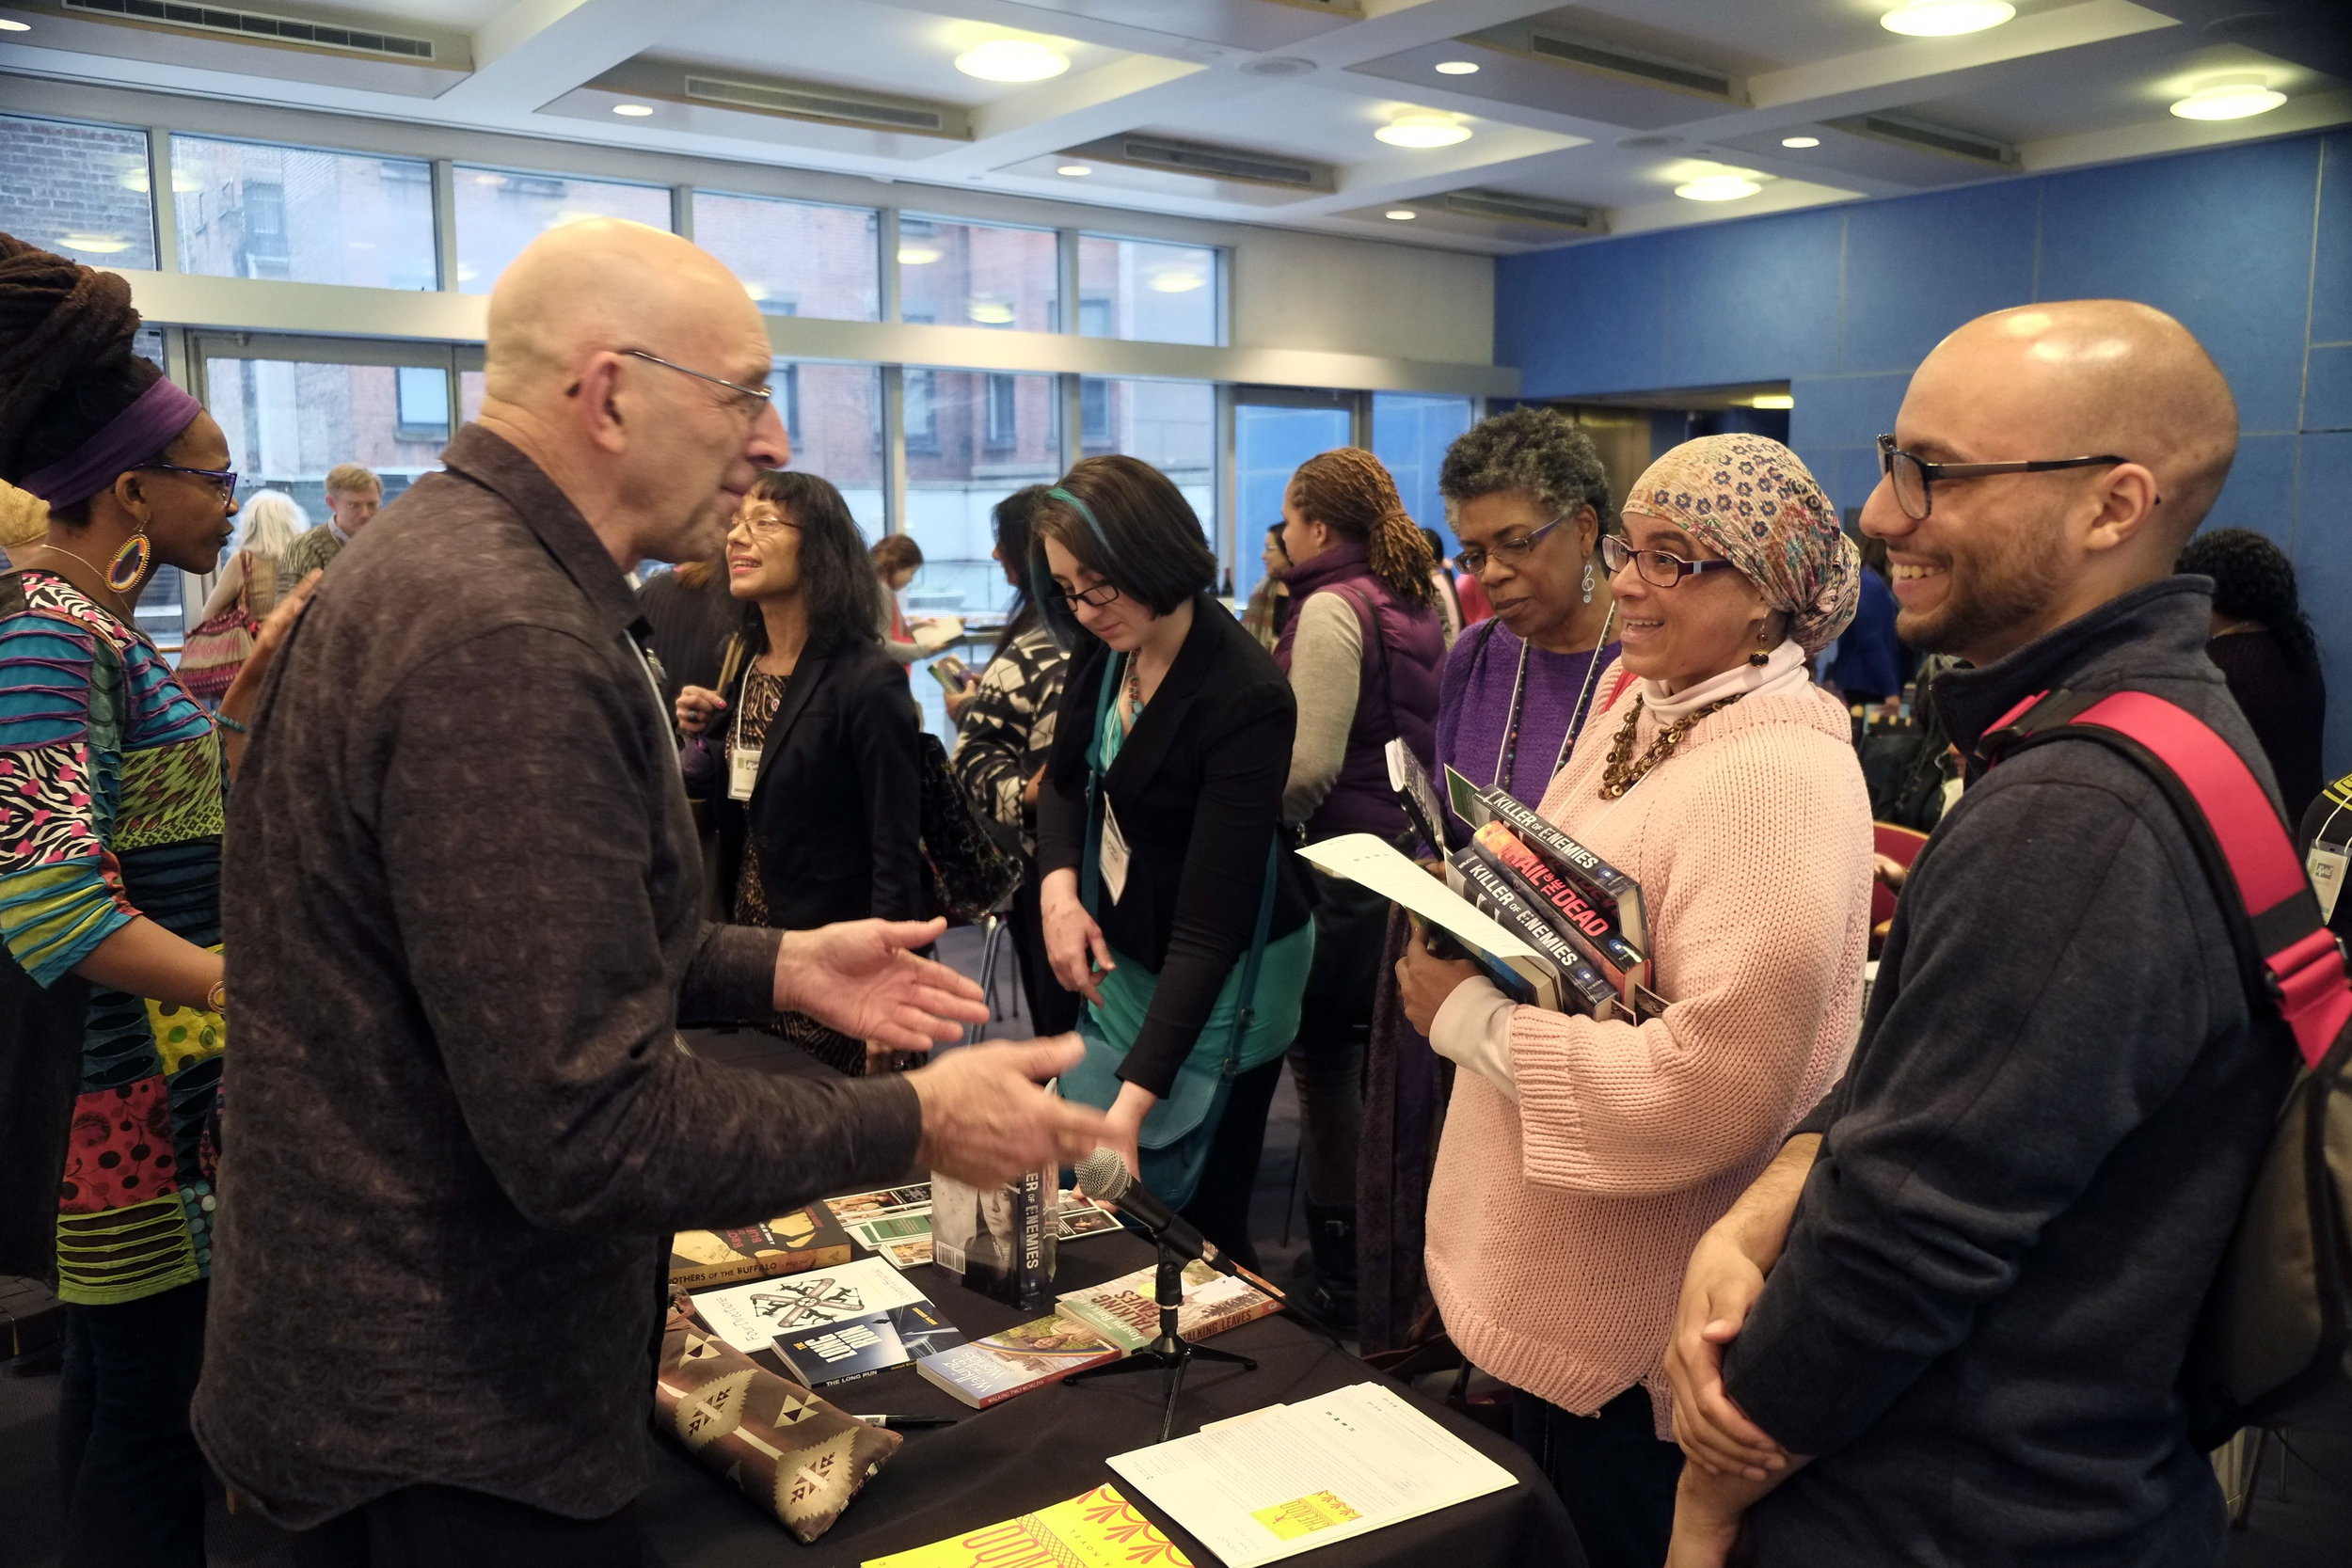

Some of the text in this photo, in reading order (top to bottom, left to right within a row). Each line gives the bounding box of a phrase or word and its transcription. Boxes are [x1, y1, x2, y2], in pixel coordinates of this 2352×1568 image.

[1493, 795, 1599, 870] KILLER OF ENEMIES
[1540, 878, 1566, 898] THE
[1469, 863, 1579, 967] KILLER OF ENEMIES
[1550, 887, 1610, 938] DEAD
[1027, 1194, 1036, 1203] OF
[1025, 1205, 1040, 1270] ENEMIES
[708, 1271, 718, 1280] OF
[721, 1270, 735, 1278] THE
[737, 1261, 777, 1275] BUFFALO
[1091, 1294, 1156, 1334] TALKING
[1115, 1290, 1160, 1324] EAVES
[834, 1324, 883, 1350] RUN
[1182, 1309, 1252, 1342] TALKING LEAVES
[804, 1333, 858, 1364] LONG
[826, 1370, 878, 1387] THE LONG RUN
